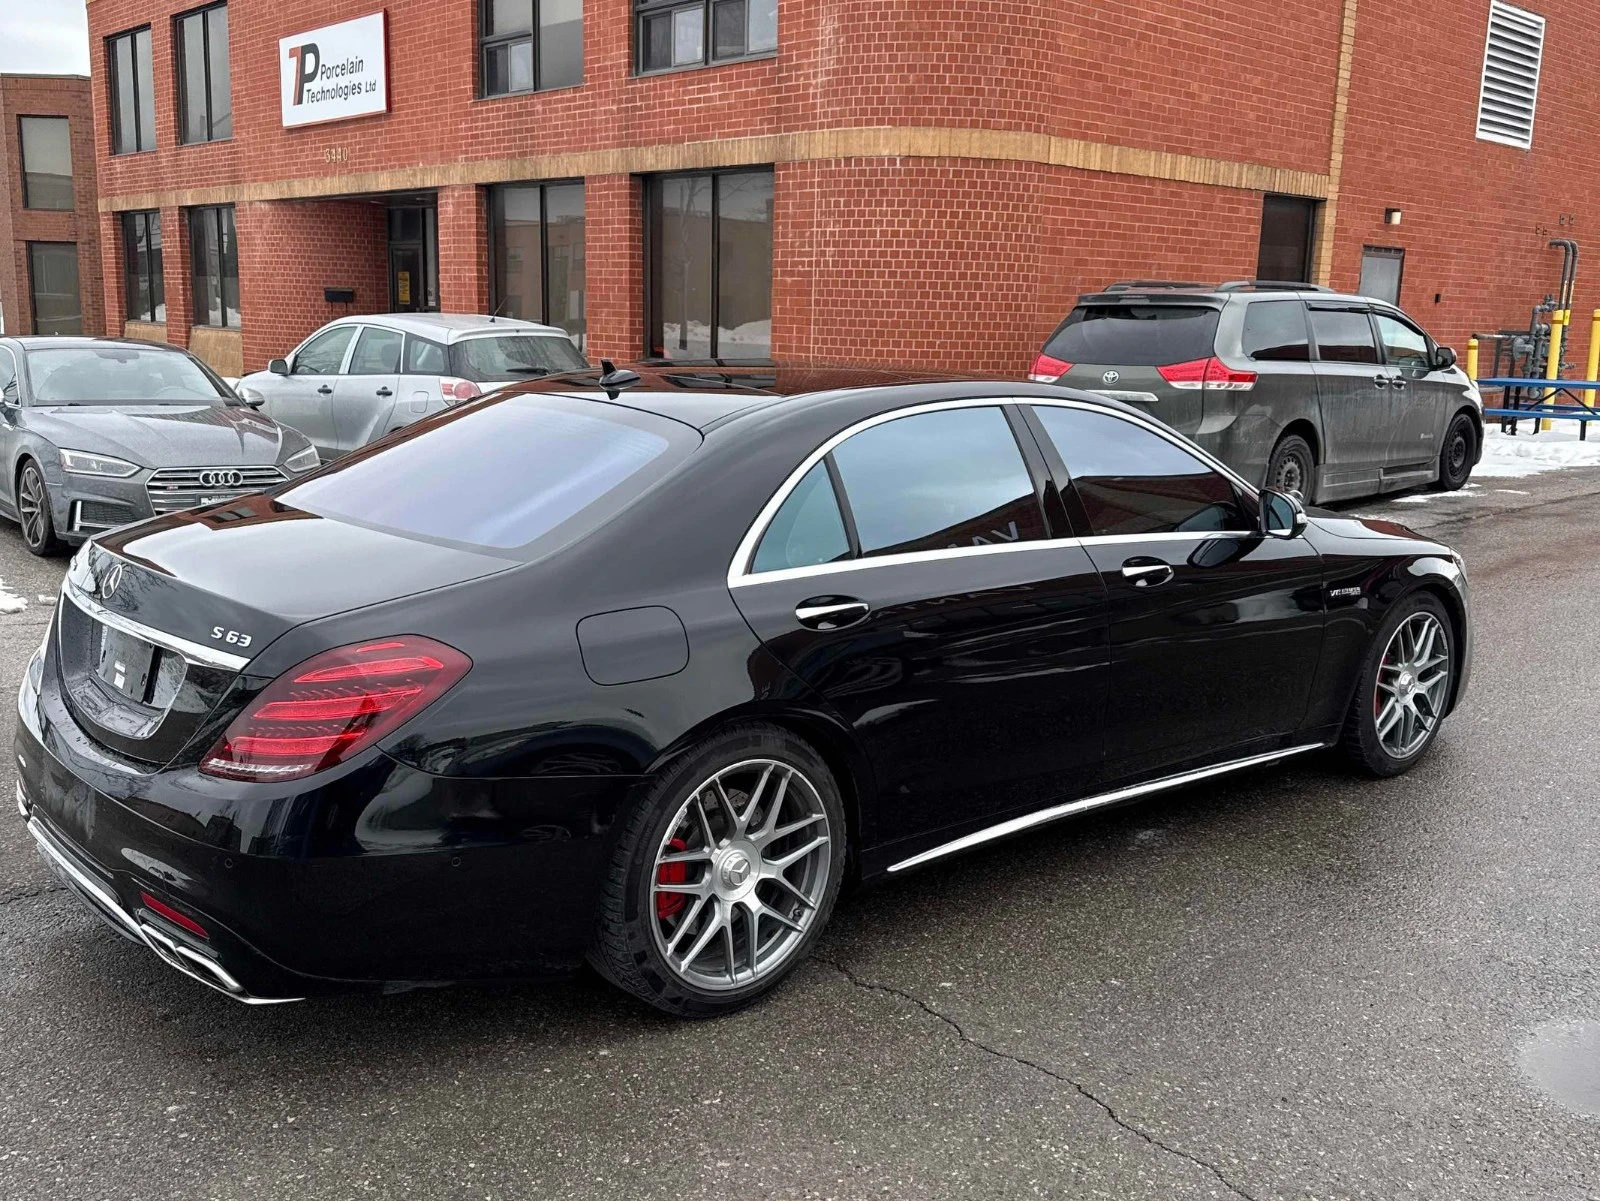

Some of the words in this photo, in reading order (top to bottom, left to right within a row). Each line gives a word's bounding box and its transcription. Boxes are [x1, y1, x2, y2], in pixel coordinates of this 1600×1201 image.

[320, 55, 364, 81] Porcelain
[306, 80, 362, 104] Technologies
[365, 79, 377, 93] Ltd
